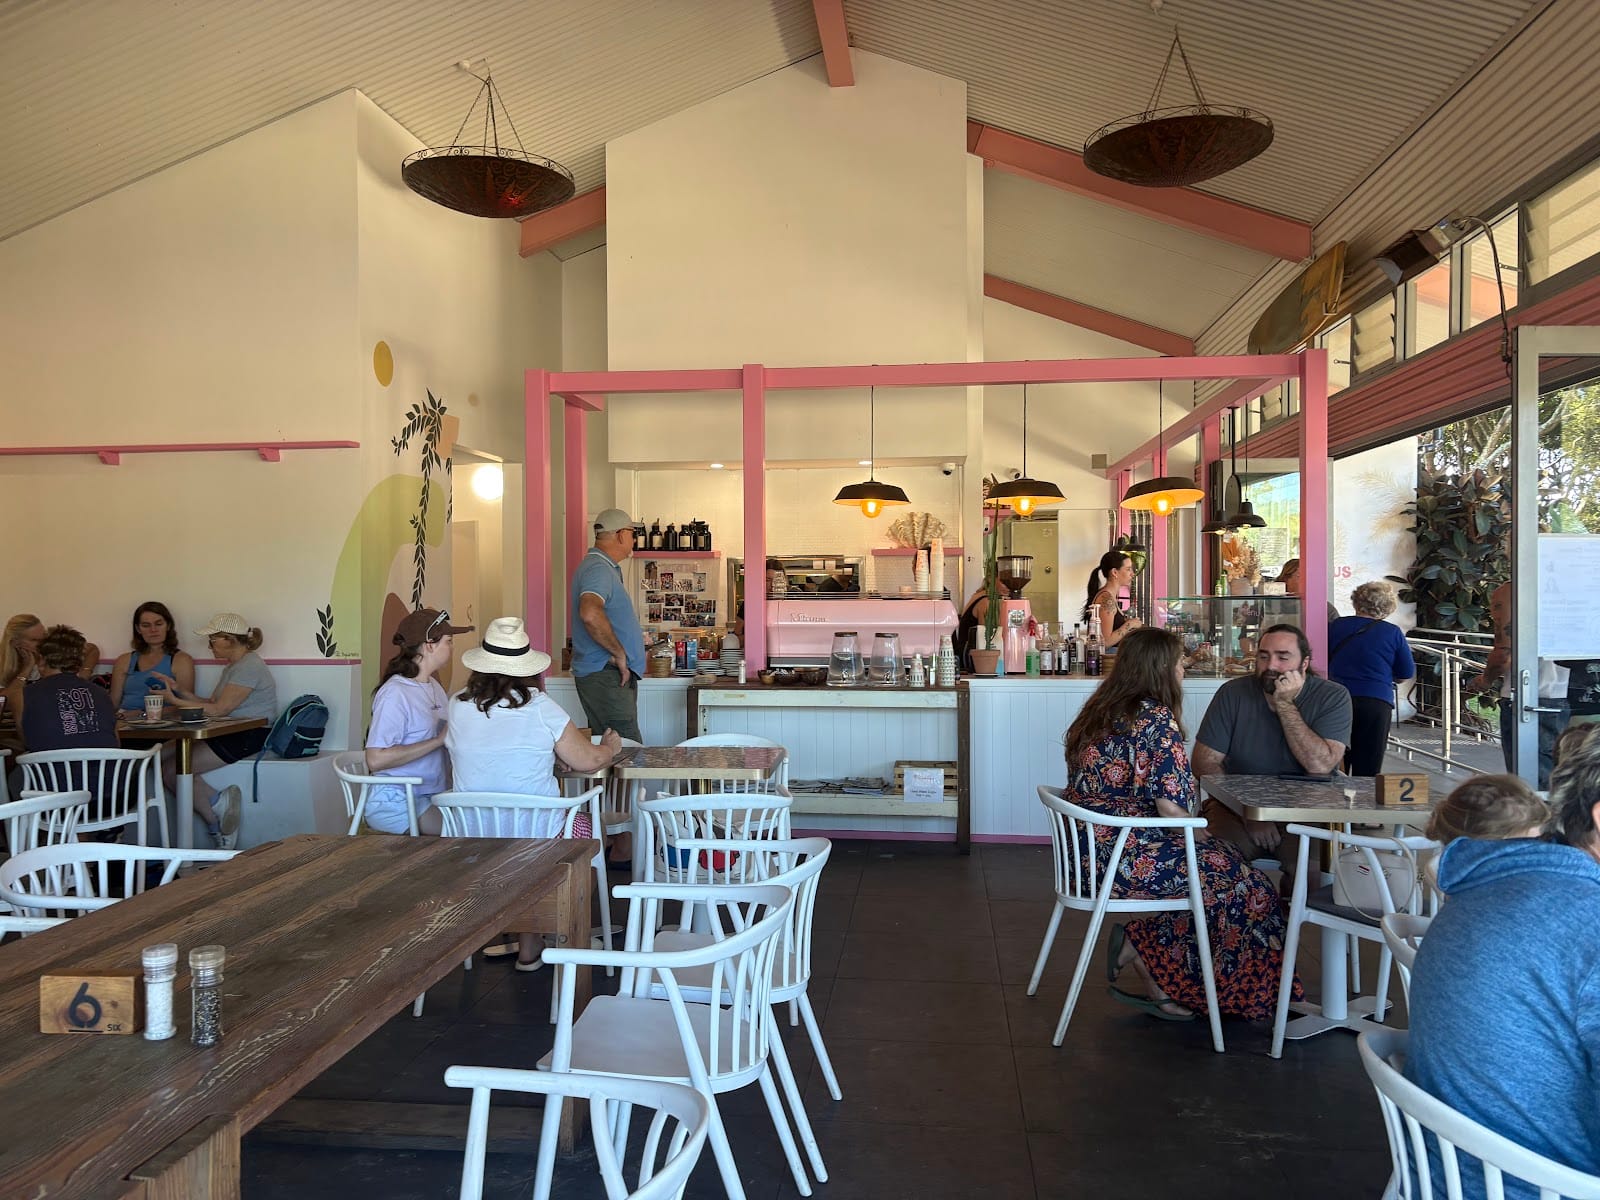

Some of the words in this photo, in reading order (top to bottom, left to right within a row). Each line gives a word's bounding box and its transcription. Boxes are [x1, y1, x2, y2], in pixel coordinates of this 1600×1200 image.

[1399, 777, 1415, 802] 2
[68, 982, 103, 1029] 6
[106, 1023, 122, 1032] SIX
